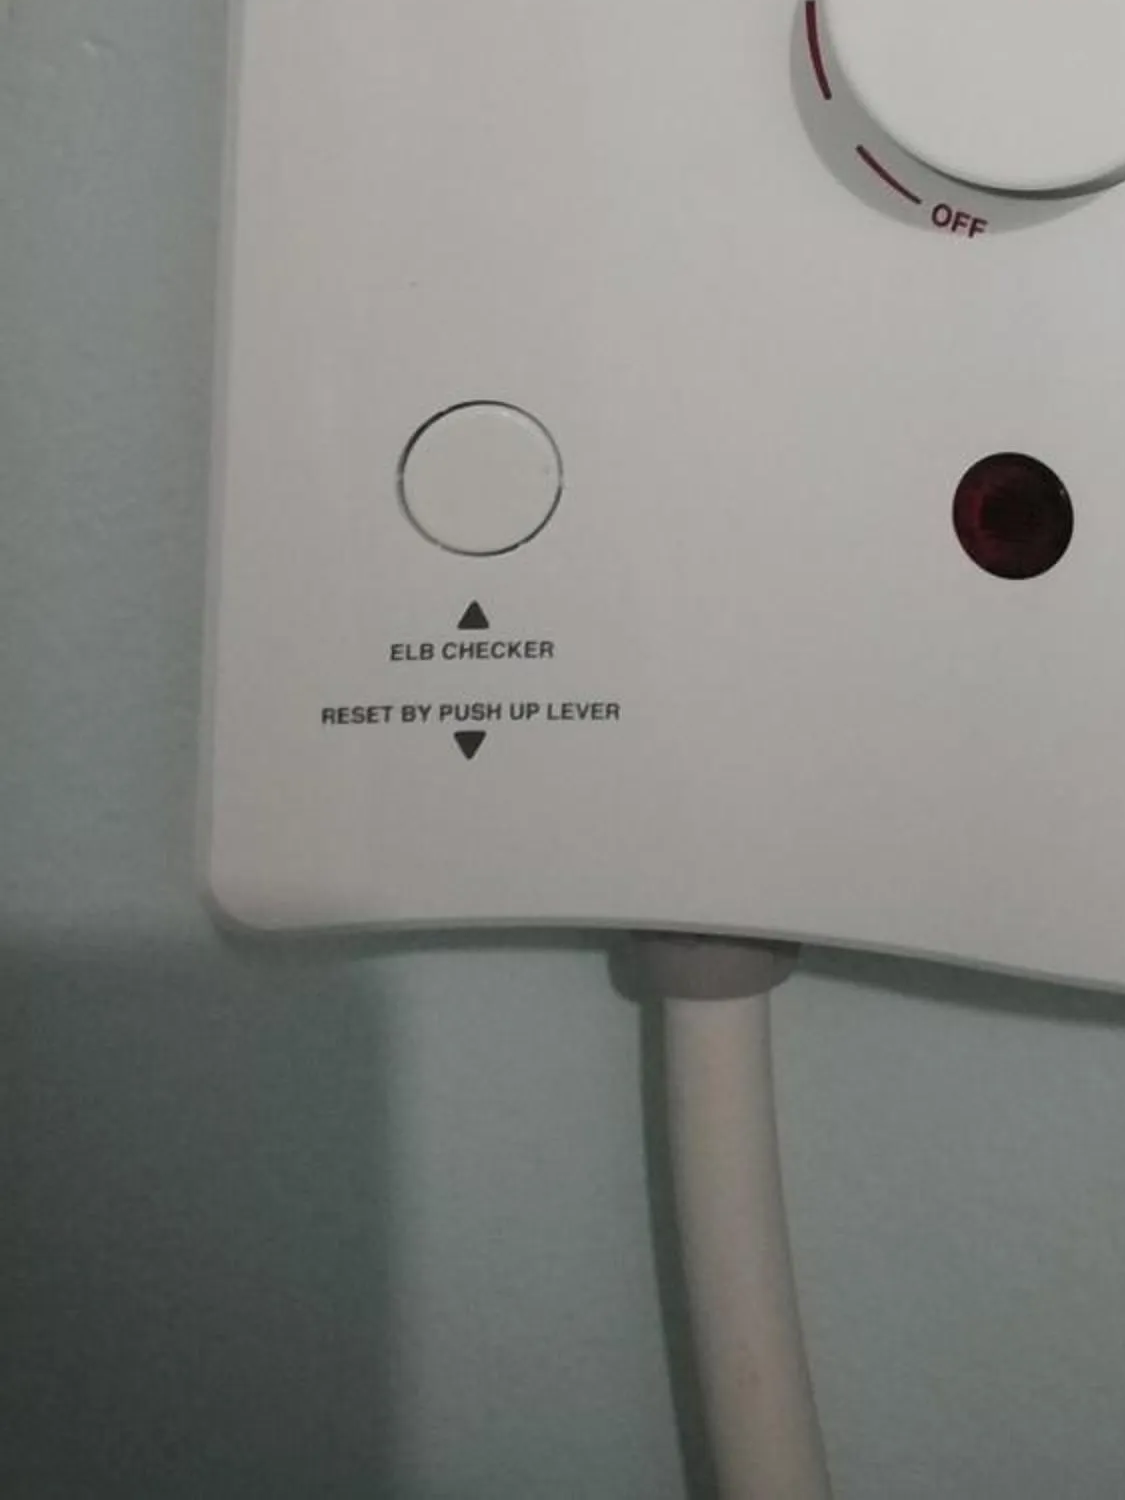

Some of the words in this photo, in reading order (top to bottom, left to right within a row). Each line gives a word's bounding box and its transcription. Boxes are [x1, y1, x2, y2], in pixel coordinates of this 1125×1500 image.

[931, 203, 988, 238] OFF
[389, 643, 435, 662] ELB
[441, 640, 556, 660] CHECKER
[320, 705, 393, 726] RESET
[401, 704, 432, 724] BY
[438, 703, 502, 722] PUSH
[509, 702, 540, 721] UP
[546, 702, 621, 722] LEVER
